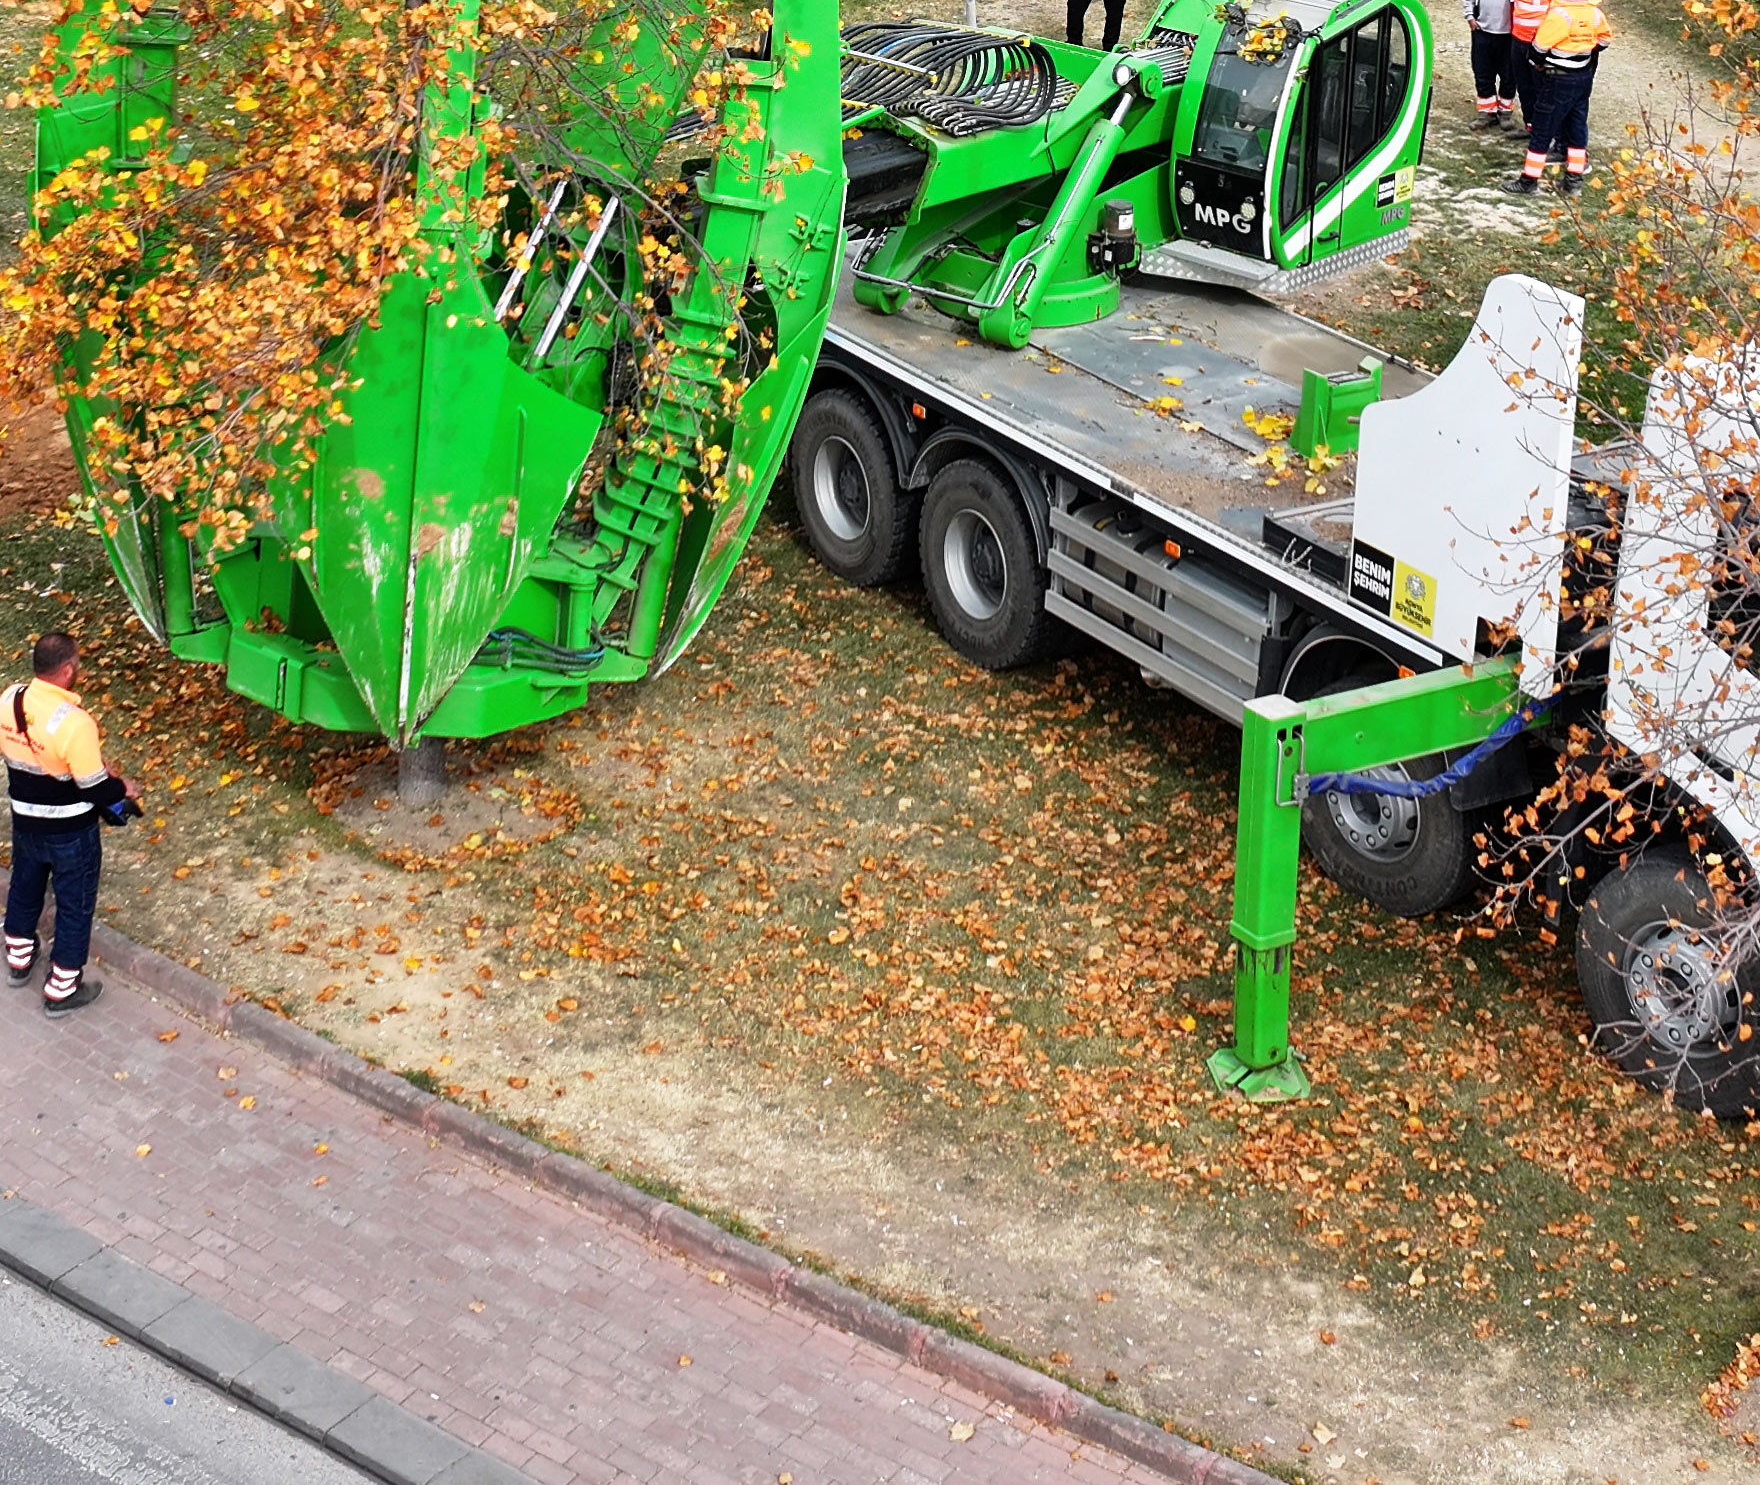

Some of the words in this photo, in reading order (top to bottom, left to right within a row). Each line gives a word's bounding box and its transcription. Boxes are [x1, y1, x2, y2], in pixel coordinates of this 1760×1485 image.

[1194, 203, 1252, 234] MPG
[1380, 205, 1405, 226] MPG
[1354, 553, 1391, 586] BENİM
[1353, 570, 1390, 601] ŞEHRİM
